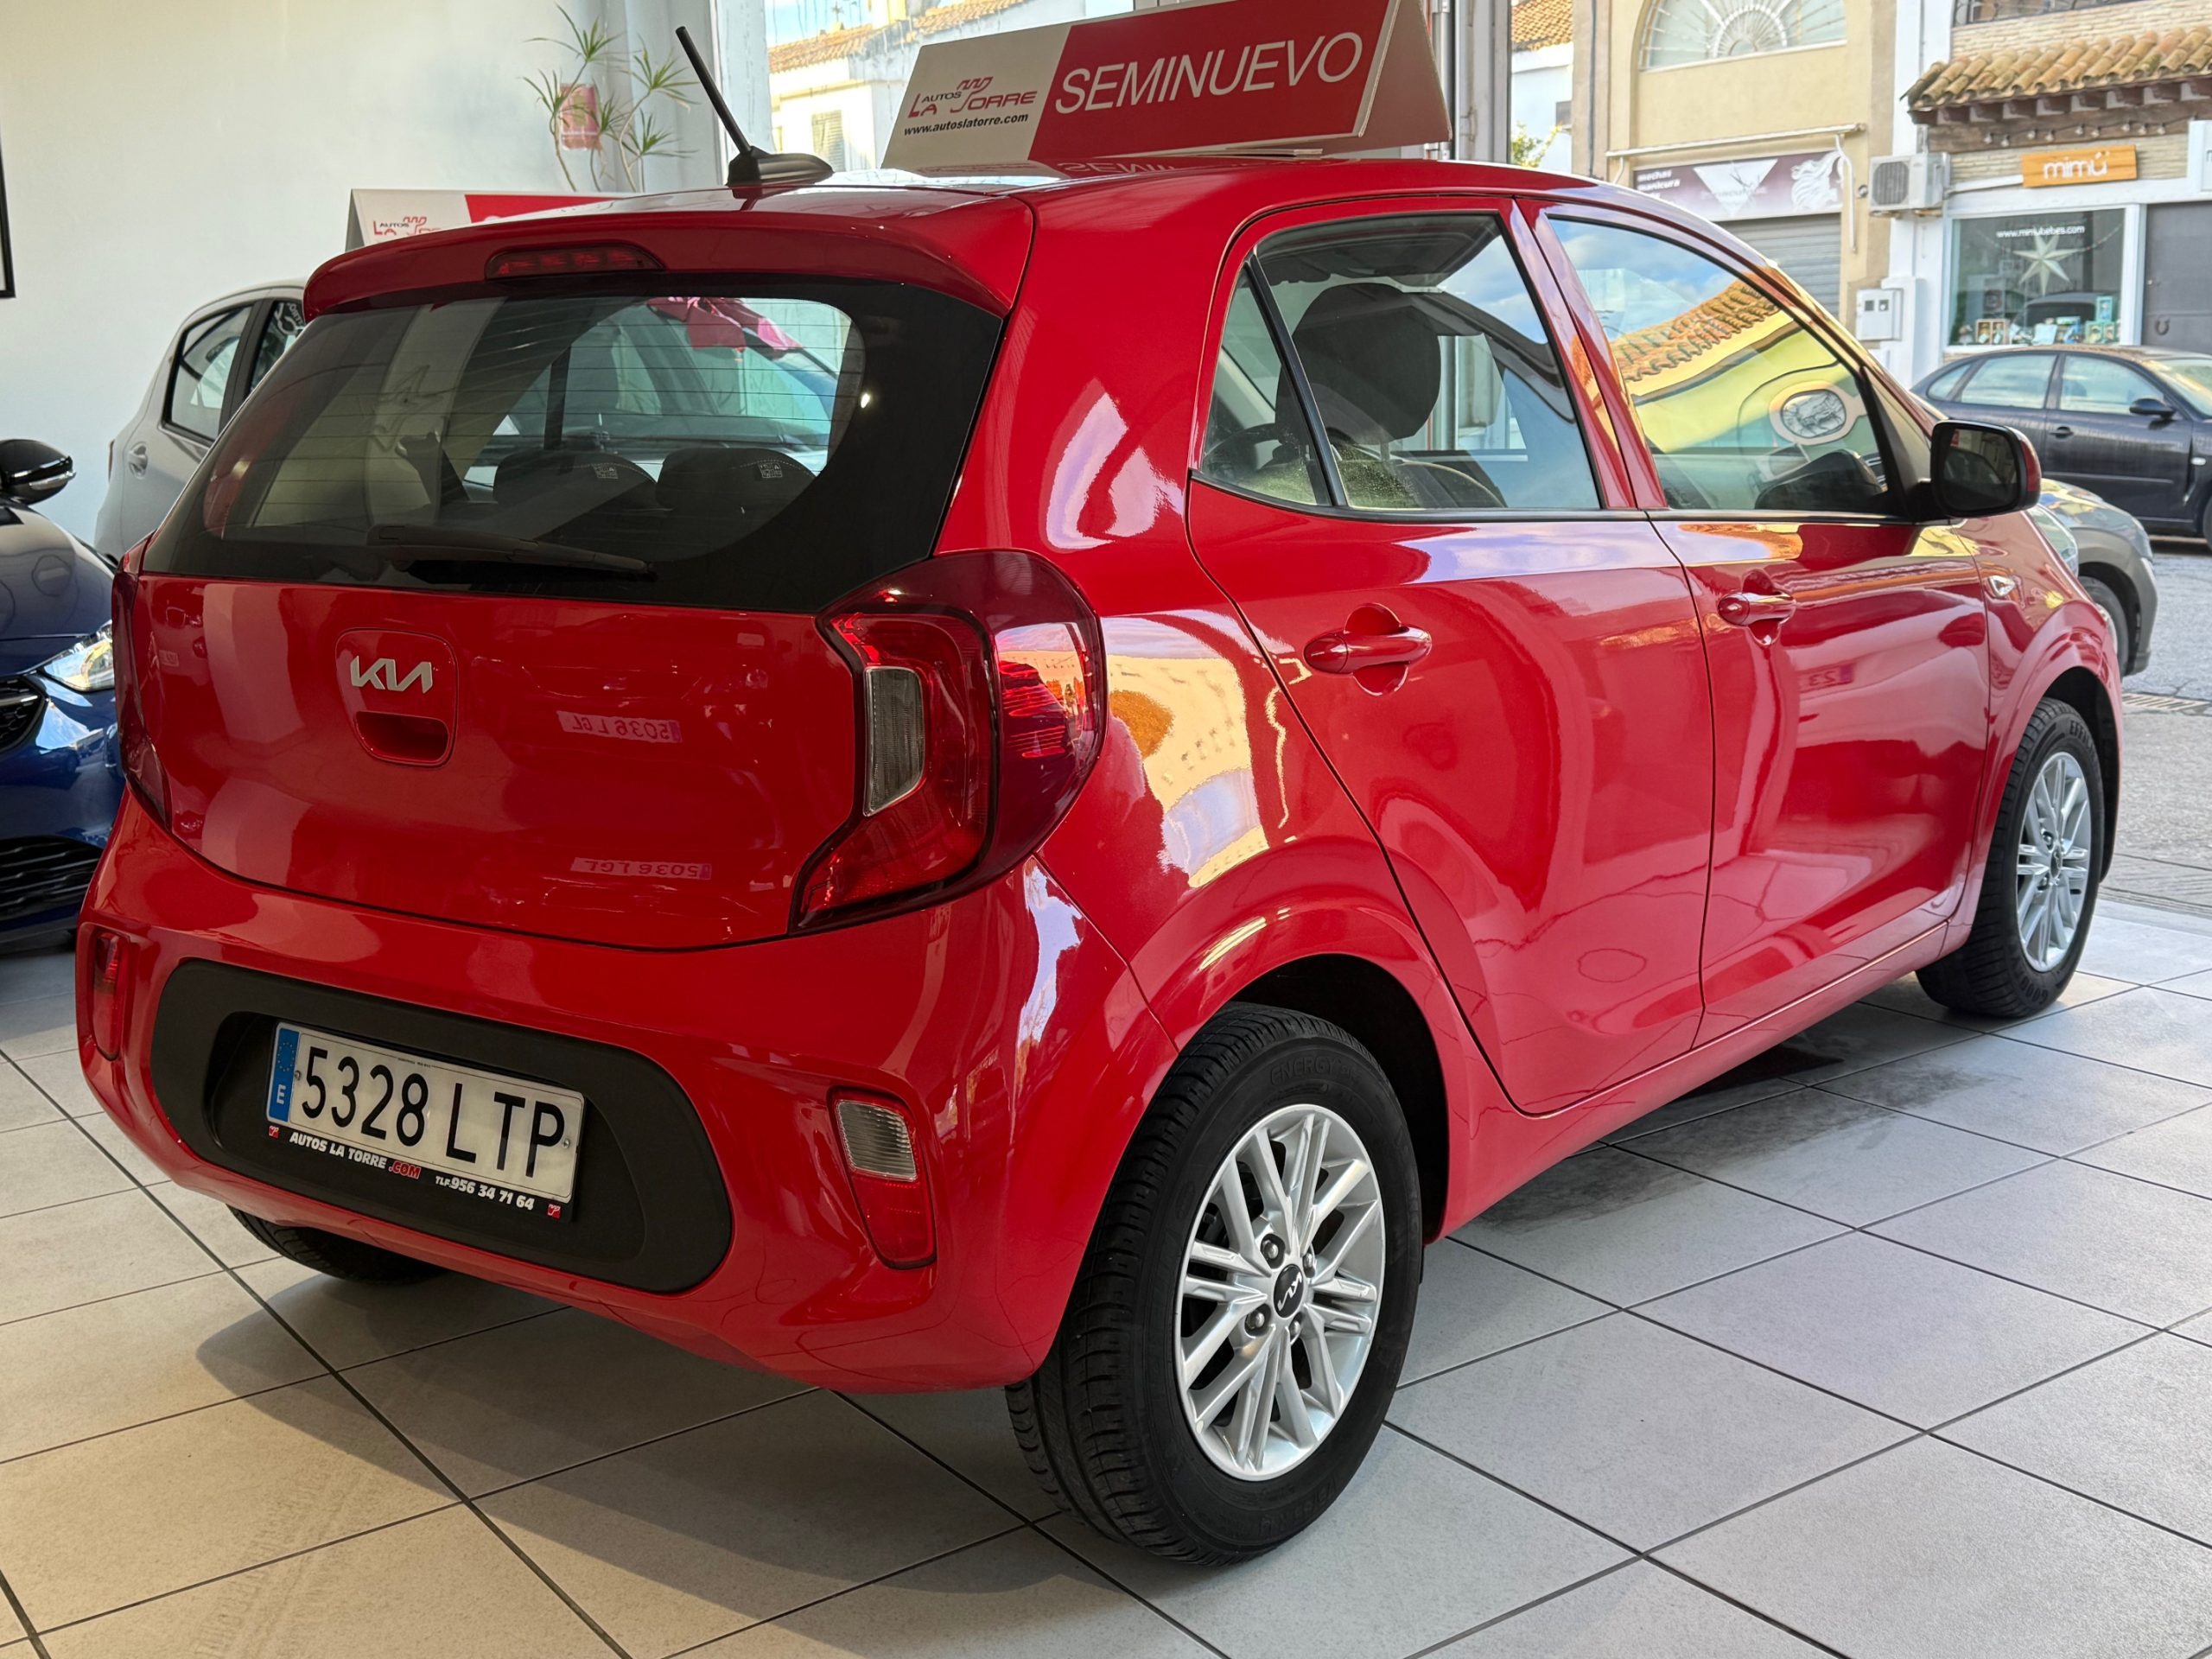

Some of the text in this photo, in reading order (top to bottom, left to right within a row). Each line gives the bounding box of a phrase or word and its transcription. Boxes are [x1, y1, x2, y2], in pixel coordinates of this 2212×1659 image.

[1055, 32, 1363, 114] SEMINUEVO
[908, 76, 1038, 118] LA TORRE
[921, 91, 963, 103] AUTOS
[904, 113, 1029, 136] www.autoslatorre.com
[350, 655, 434, 694] KIA
[276, 1084, 287, 1105] E
[302, 1046, 565, 1178] 5328 LTP
[289, 1131, 422, 1180] AUTOS LA TORRE .COM
[478, 1184, 497, 1200] 34
[499, 1190, 513, 1205] 71
[516, 1194, 535, 1211] 64
